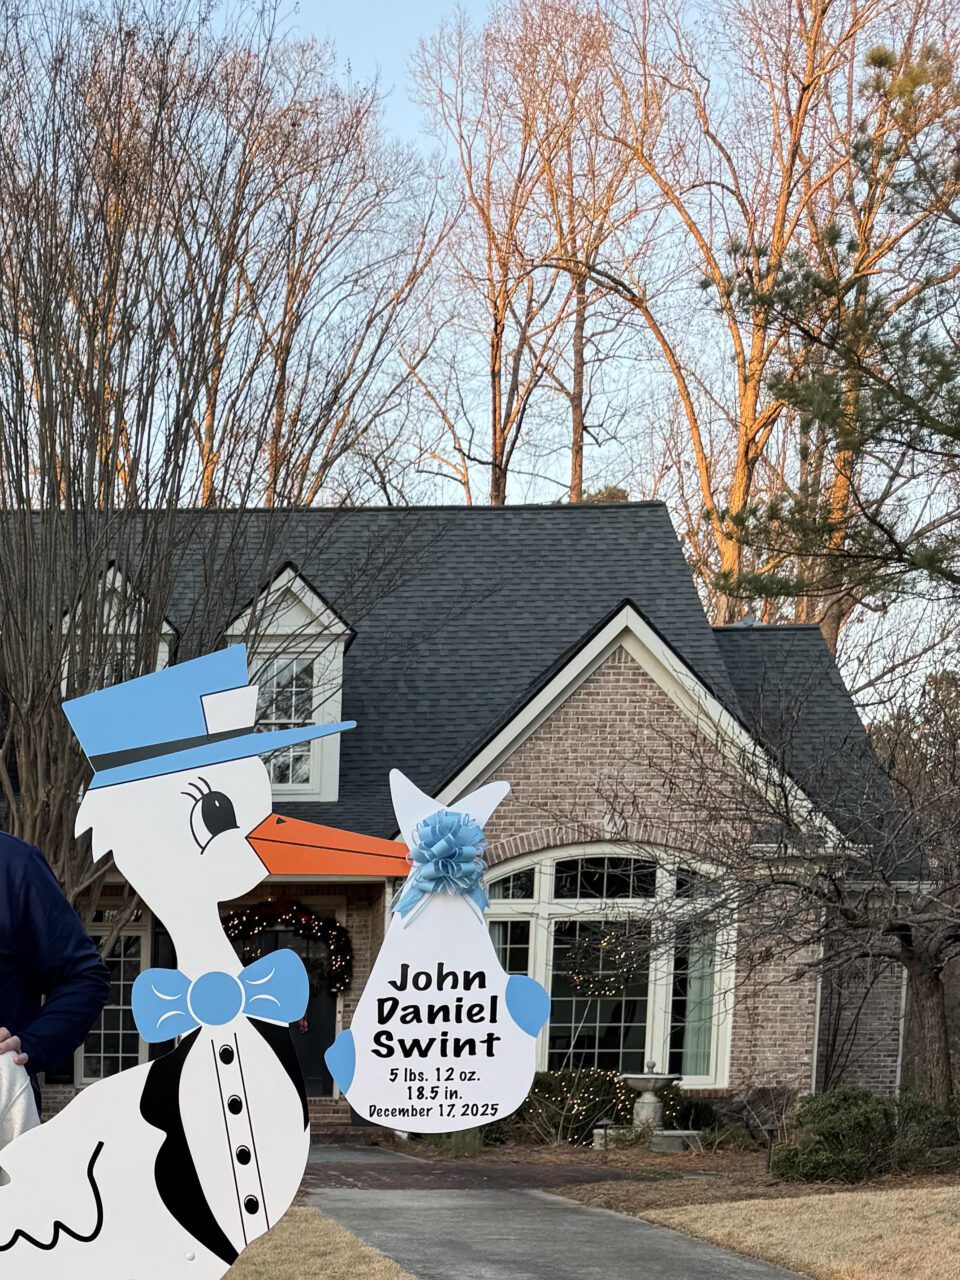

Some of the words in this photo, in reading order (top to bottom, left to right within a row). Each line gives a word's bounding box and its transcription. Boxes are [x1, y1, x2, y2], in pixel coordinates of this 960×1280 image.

[387, 962, 487, 992] John
[376, 994, 499, 1026] Daniel
[370, 1029, 502, 1059] Swint
[388, 1067, 400, 1083] 5
[404, 1067, 429, 1083] lbs.
[435, 1066, 456, 1082] 12
[459, 1070, 481, 1082] oz.
[407, 1085, 440, 1101] 18.5
[444, 1086, 463, 1100] in.
[369, 1104, 434, 1118] December
[439, 1103, 457, 1119] 17,
[460, 1103, 500, 1117] 2025
